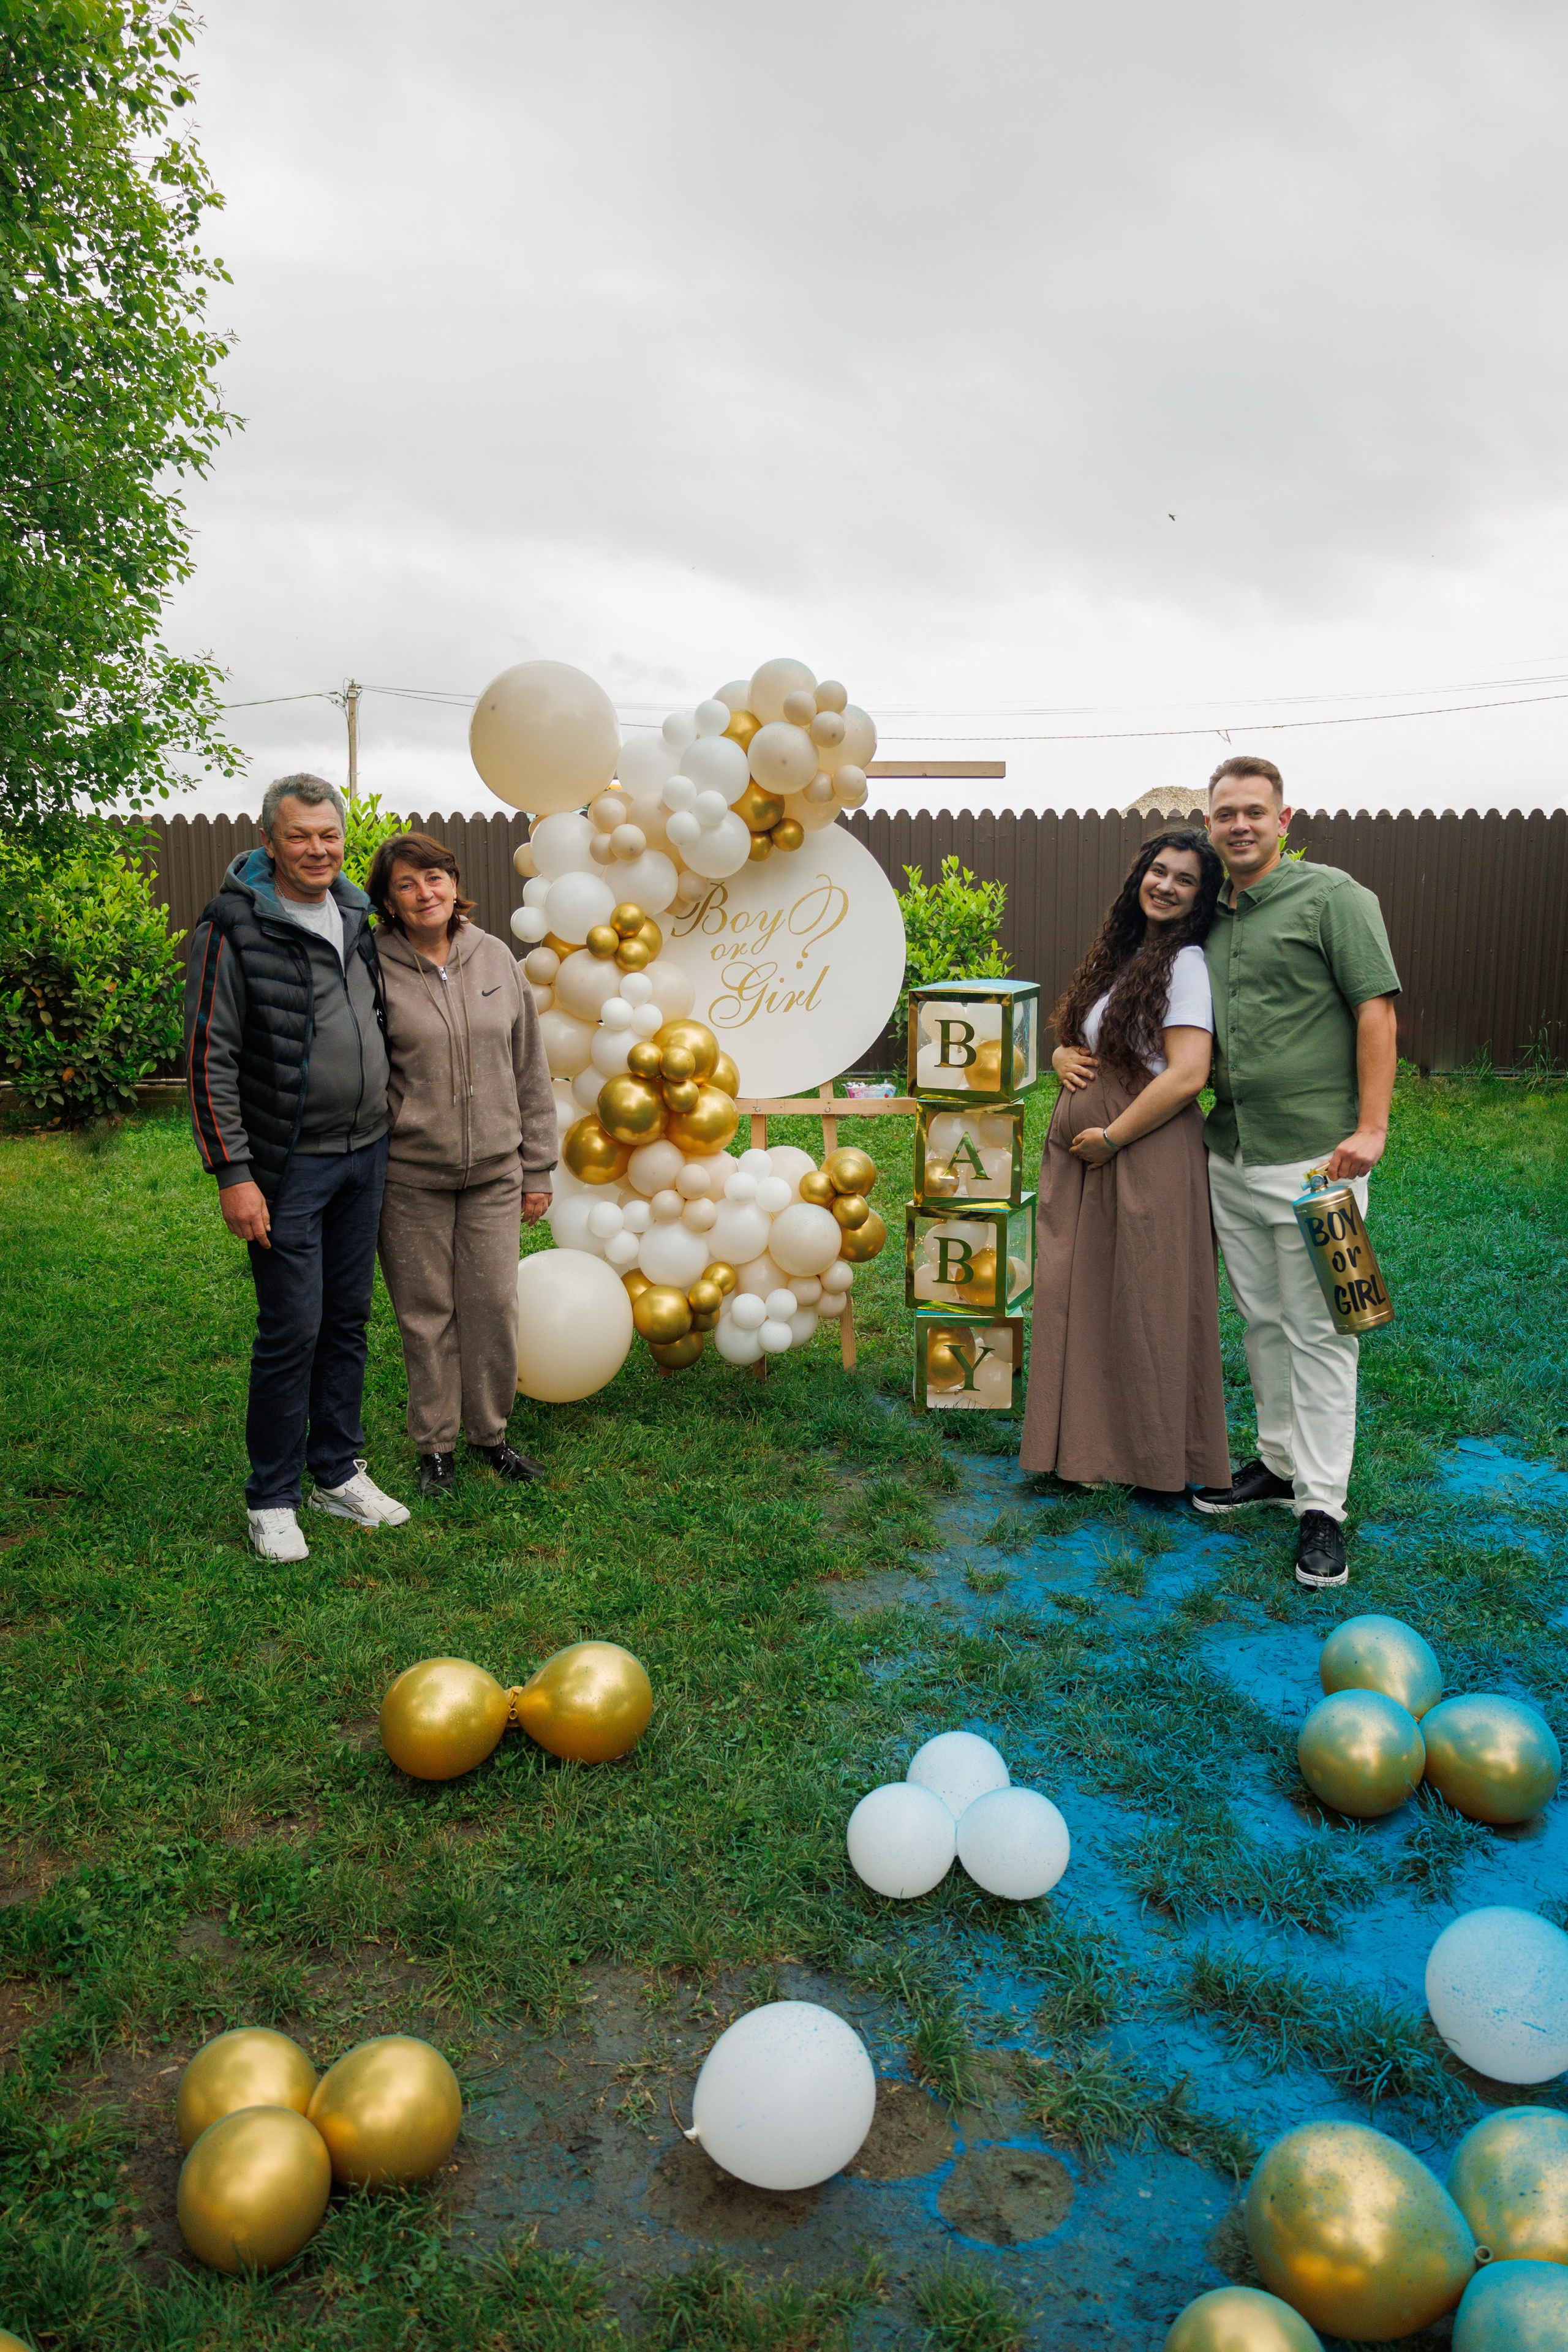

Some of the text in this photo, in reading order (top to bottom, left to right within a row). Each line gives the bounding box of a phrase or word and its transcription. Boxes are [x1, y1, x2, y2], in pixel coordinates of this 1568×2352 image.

[710, 942, 748, 961] or
[708, 961, 831, 1029] Girl
[1304, 1204, 1358, 1247] BOY
[1332, 1245, 1362, 1273] or
[1333, 1274, 1386, 1315] GIRL
